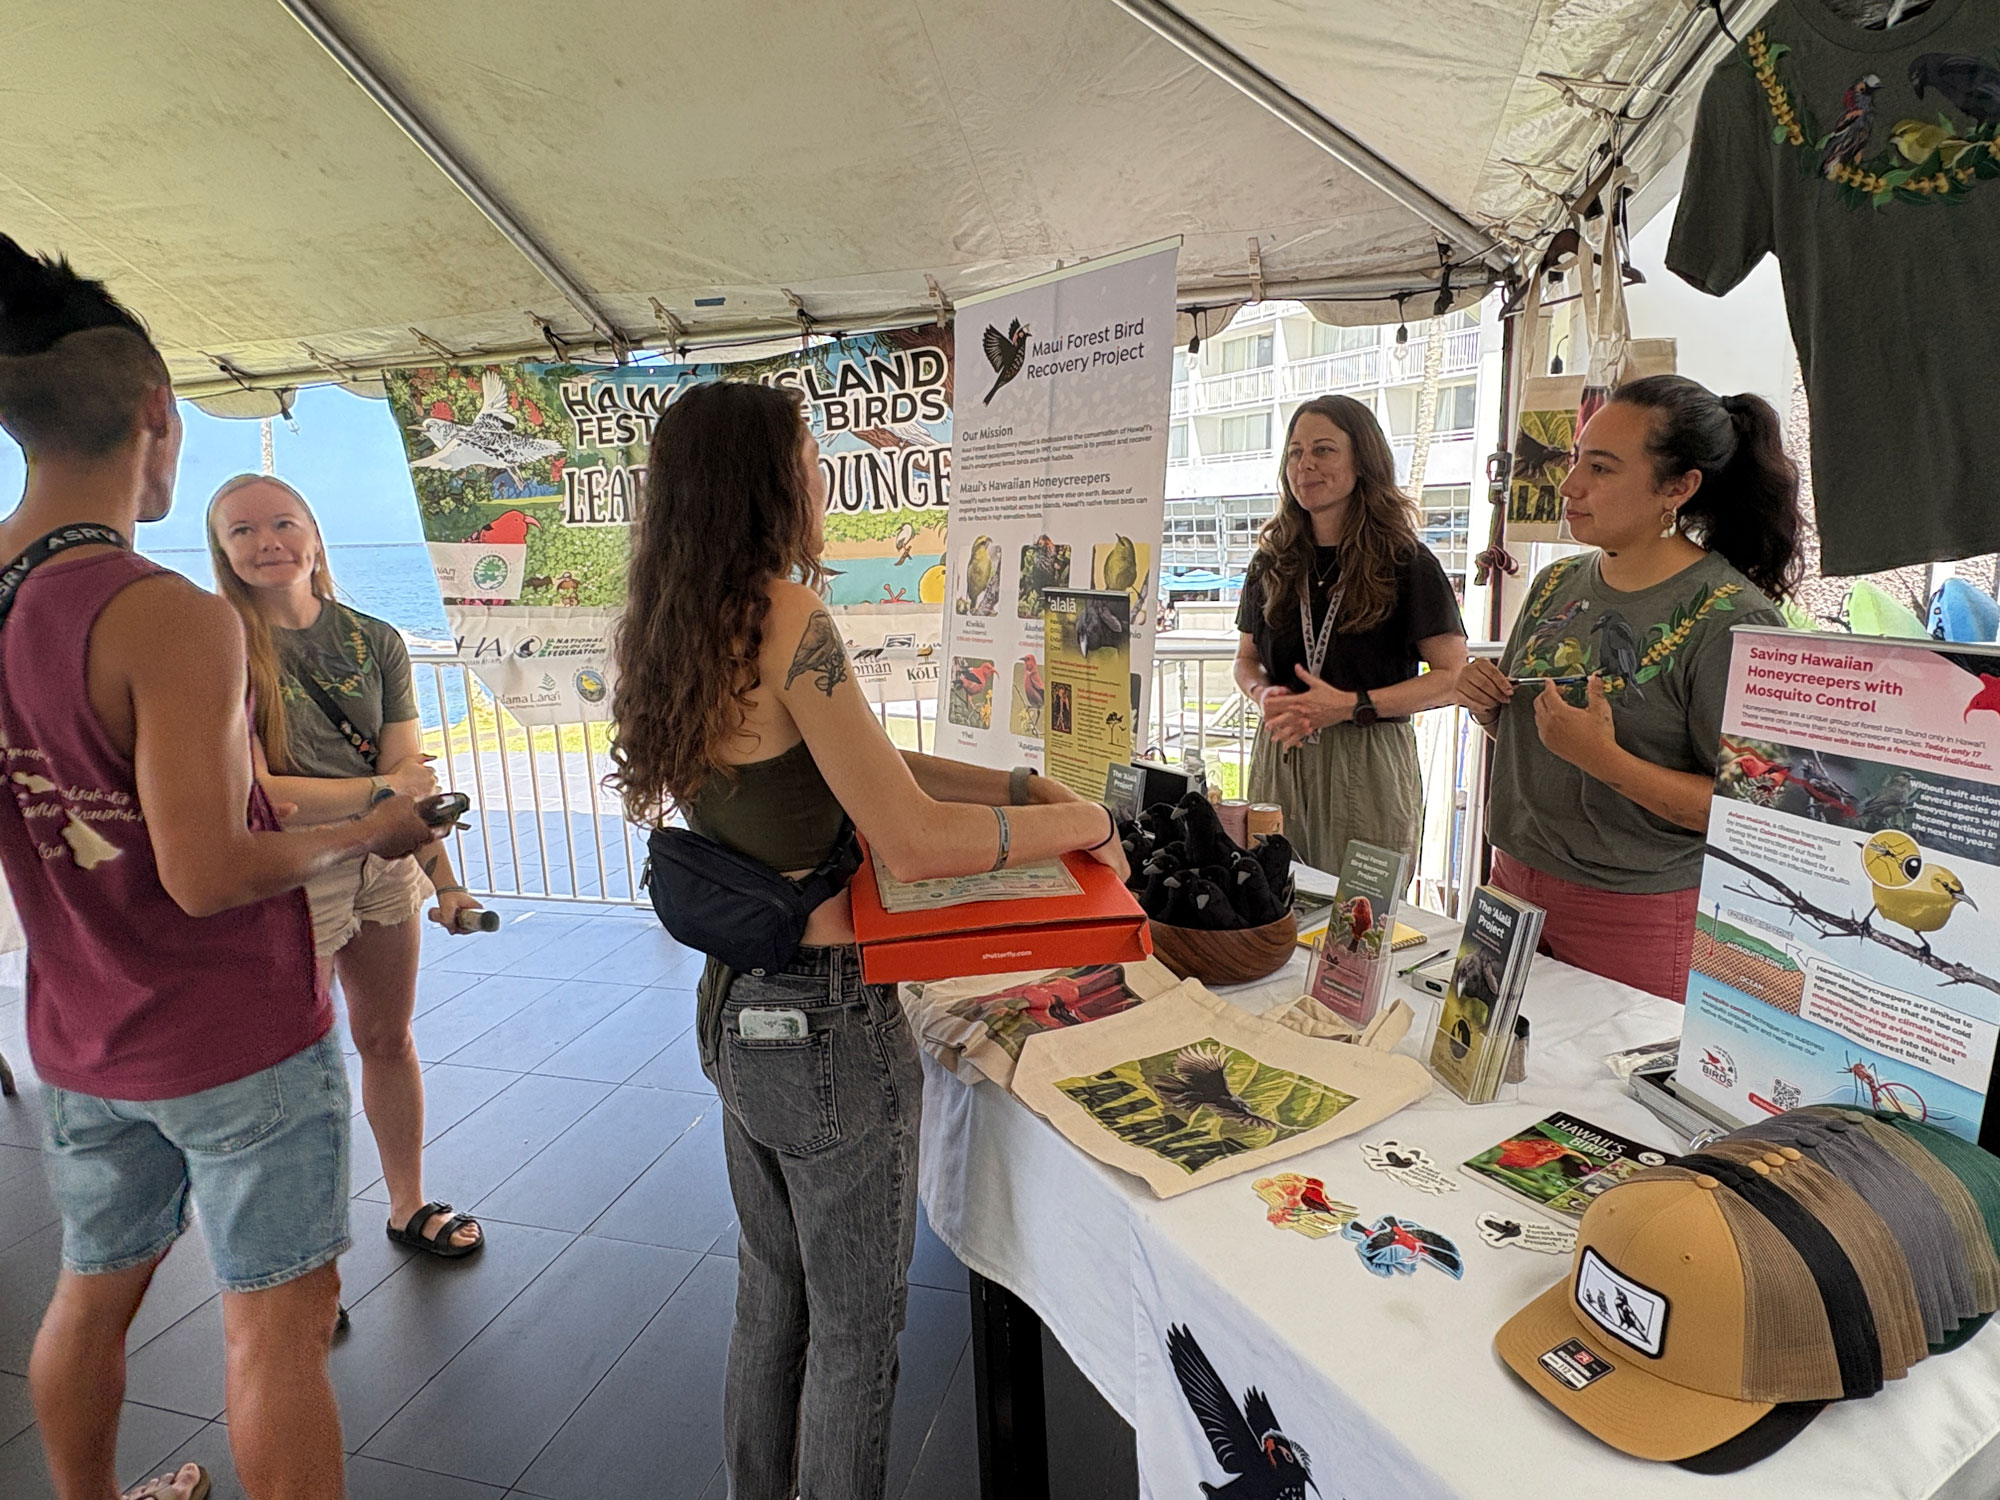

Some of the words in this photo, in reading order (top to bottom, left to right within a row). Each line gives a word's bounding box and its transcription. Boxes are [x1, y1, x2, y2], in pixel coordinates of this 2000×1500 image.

[1032, 336, 1064, 358] Maui
[1068, 326, 1110, 348] Forest
[1114, 318, 1144, 339] Bird
[1027, 356, 1089, 380] Recovery
[1092, 342, 1144, 367] Project
[823, 388, 945, 430] BIRDS
[962, 431, 978, 441] Our
[980, 426, 1013, 440] Mission
[960, 480, 987, 493] Maui's
[988, 477, 1031, 491] Hawaiian
[1033, 473, 1110, 489] Honeycreepers
[547, 648, 607, 657] FEDERATION
[1750, 646, 1797, 665] Saving
[1801, 651, 1873, 671] Hawaiian
[1747, 665, 1861, 691] Honeycreepers
[1863, 678, 1903, 695] with
[1745, 682, 1812, 704] Mosquito
[1815, 692, 1876, 712] Control
[1811, 723, 1826, 731] than
[1837, 728, 1890, 742] honeycreeper
[1924, 742, 1950, 753] Today,
[1951, 746, 1969, 756] only
[1829, 718, 1850, 726] group
[1860, 722, 1881, 730] forest
[1904, 729, 1926, 738] found
[1927, 733, 1945, 742] only
[1866, 742, 1885, 751] than
[1893, 747, 1908, 755] few
[1910, 749, 1942, 761] hundred
[1112, 770, 1122, 778] The
[1114, 780, 1134, 790] Project
[1909, 779, 1944, 793] Without
[1945, 786, 1969, 799] swift
[1912, 801, 1980, 824] honeycreepers
[1980, 816, 2000, 828] will
[1920, 793, 1952, 806] several
[1951, 799, 1989, 814] species
[1911, 822, 1926, 832] the
[1926, 826, 1947, 837] next
[1947, 831, 1964, 842] ten
[1964, 836, 1996, 851] years.
[1915, 812, 1951, 827] become
[1951, 821, 1986, 836] extinct
[1987, 829, 1998, 838] in
[1350, 860, 1364, 868] Bird
[1363, 863, 1389, 878] Recovery
[1356, 852, 1370, 862] Maui
[1370, 855, 1388, 867] Forest
[1357, 870, 1378, 883] Project
[1478, 899, 1492, 914] The
[1477, 915, 1504, 939] Project
[982, 950, 1032, 960] shutterfly.com
[1727, 942, 1764, 961] MOSQUITO
[1765, 958, 1784, 969] ZONE
[1740, 975, 1764, 990] OCEAN
[1814, 975, 1836, 987] upper
[1868, 995, 1899, 1012] forests
[1900, 1006, 1920, 1018] that
[1920, 1015, 1934, 1024] are
[1935, 1020, 1951, 1030] too
[1951, 1026, 1972, 1038] cold
[1816, 965, 1851, 982] Hawaiian
[1850, 978, 1912, 1007] honeycreepers
[1912, 1002, 1928, 1011] are
[1929, 1007, 1961, 1023] limited
[1961, 1019, 1973, 1028] to
[1811, 992, 1854, 1013] mosquitoes
[1853, 1009, 1888, 1029] carrying
[1888, 1023, 1915, 1038] avian
[1916, 1033, 1950, 1051] malaria
[1951, 1048, 1967, 1058] are
[1813, 983, 1826, 991] for
[1868, 1006, 1880, 1015] As
[1880, 1010, 1897, 1021] the
[1897, 1016, 1932, 1034] climate
[1933, 1031, 1967, 1048] warms,
[1808, 1009, 1834, 1025] refuge
[1834, 1020, 1843, 1028] of
[1842, 1024, 1875, 1043] Hawaiian
[1875, 1039, 1904, 1055] forest
[1905, 1050, 1932, 1065] birds.
[1809, 1001, 1838, 1017] moving
[1838, 1012, 1864, 1028] further
[1862, 1023, 1899, 1043] upslope
[1899, 1037, 1920, 1050] into
[1920, 1045, 1938, 1057] this
[1938, 1052, 1956, 1064] last
[1702, 1065, 1733, 1087] BIRDS
[1555, 1120, 1628, 1154] HAWAII'S
[1568, 1137, 1618, 1162] BIRDS
[1525, 1234, 1567, 1243] Recovery
